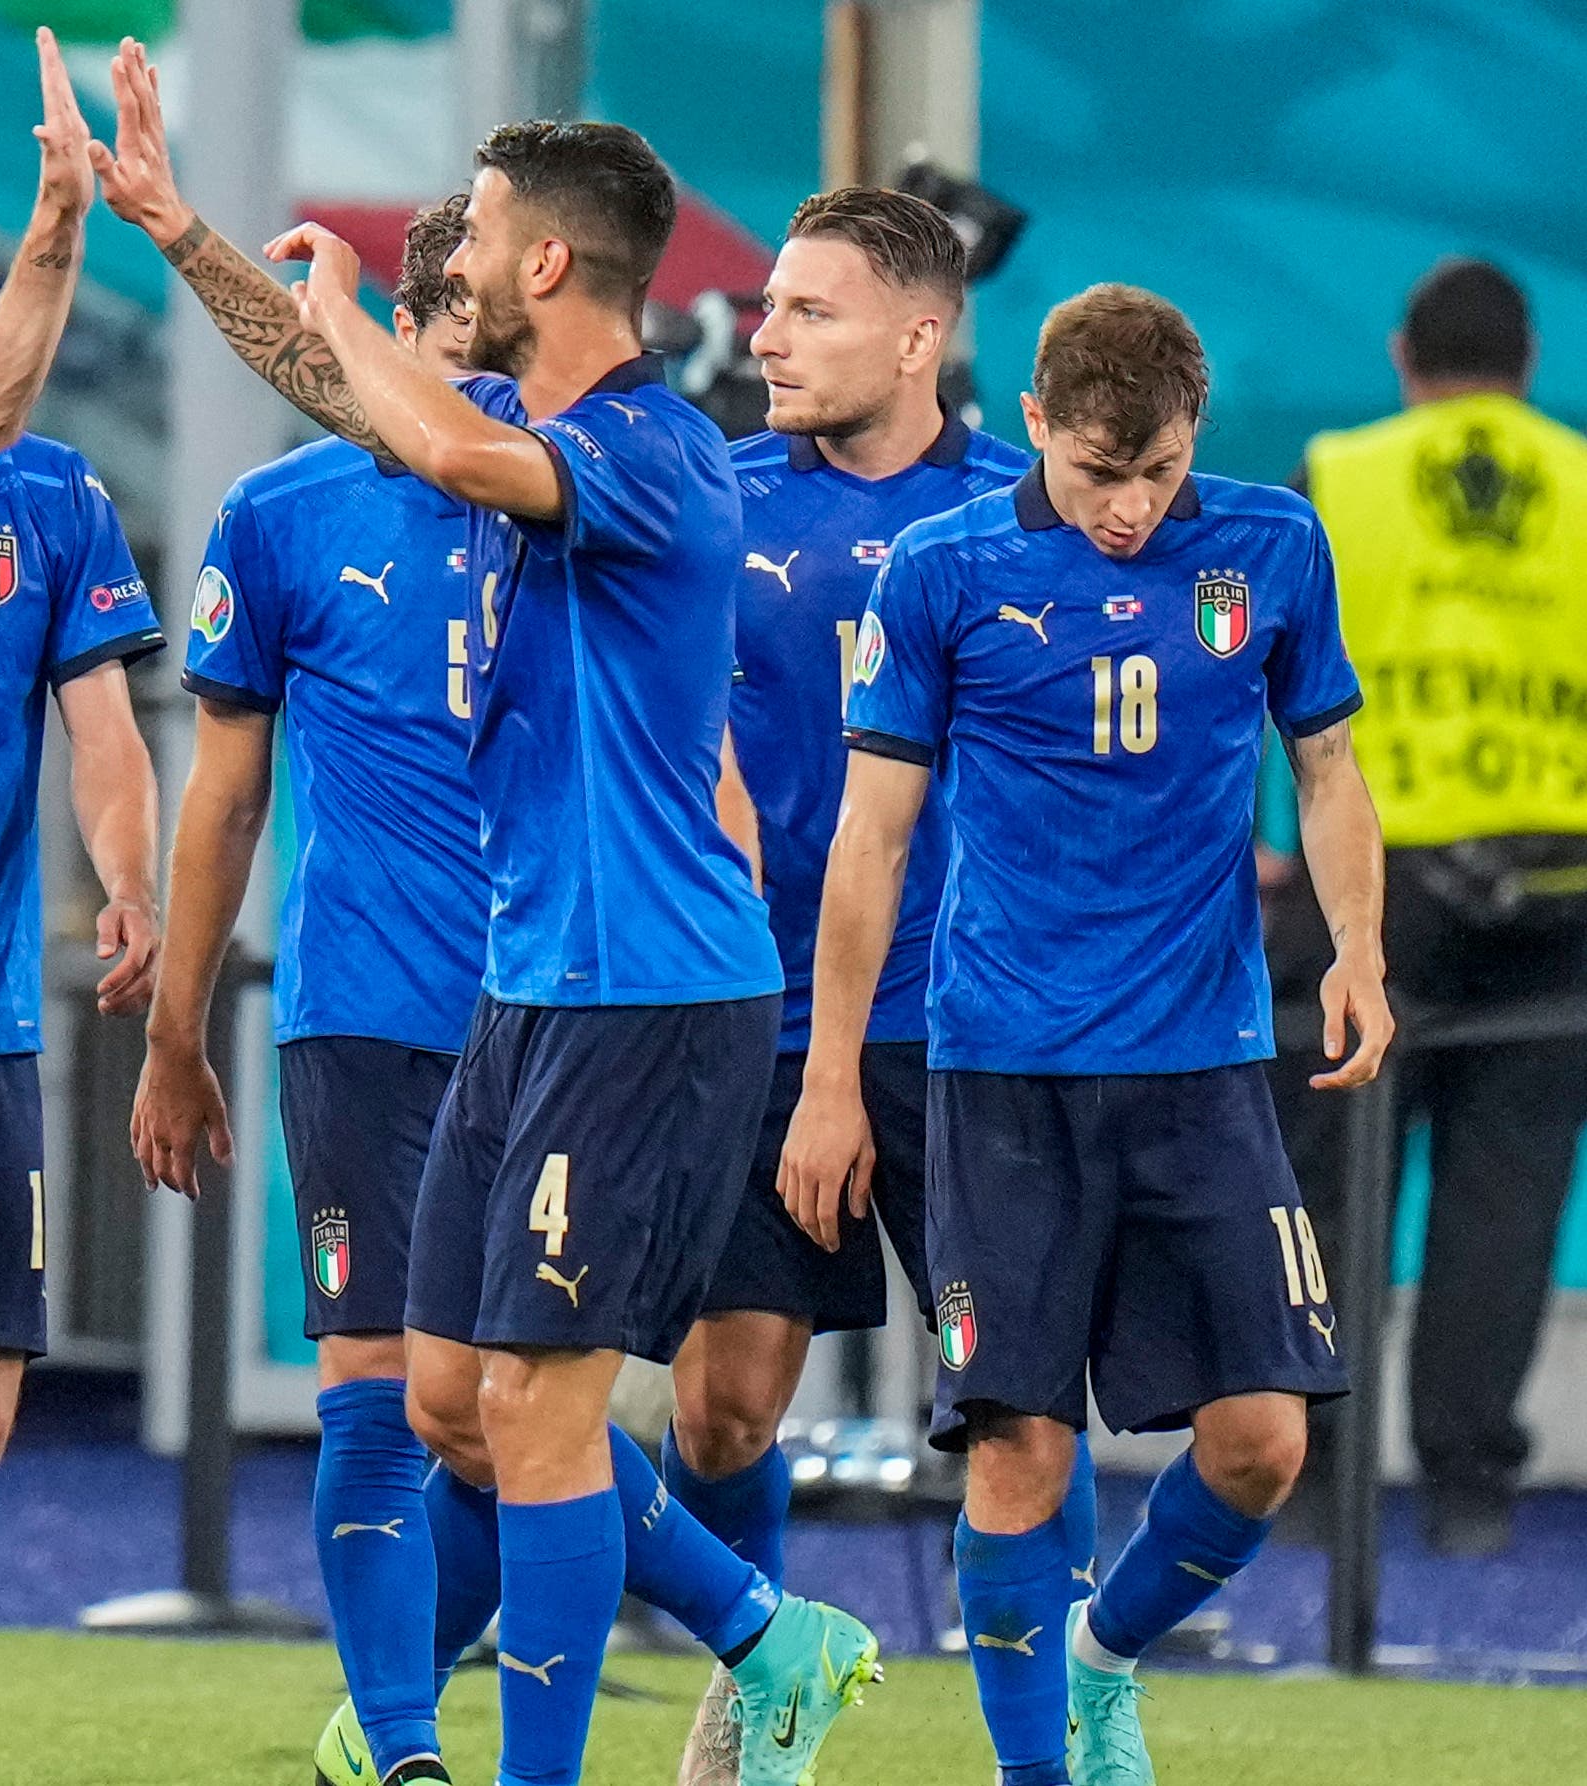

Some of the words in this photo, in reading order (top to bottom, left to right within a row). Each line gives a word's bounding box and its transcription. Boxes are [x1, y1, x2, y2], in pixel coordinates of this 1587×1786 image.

[1200, 585, 1244, 600] ITALIA
[1091, 654, 1158, 755] 18
[529, 1153, 569, 1256] 4
[1269, 1206, 1328, 1306] 18
